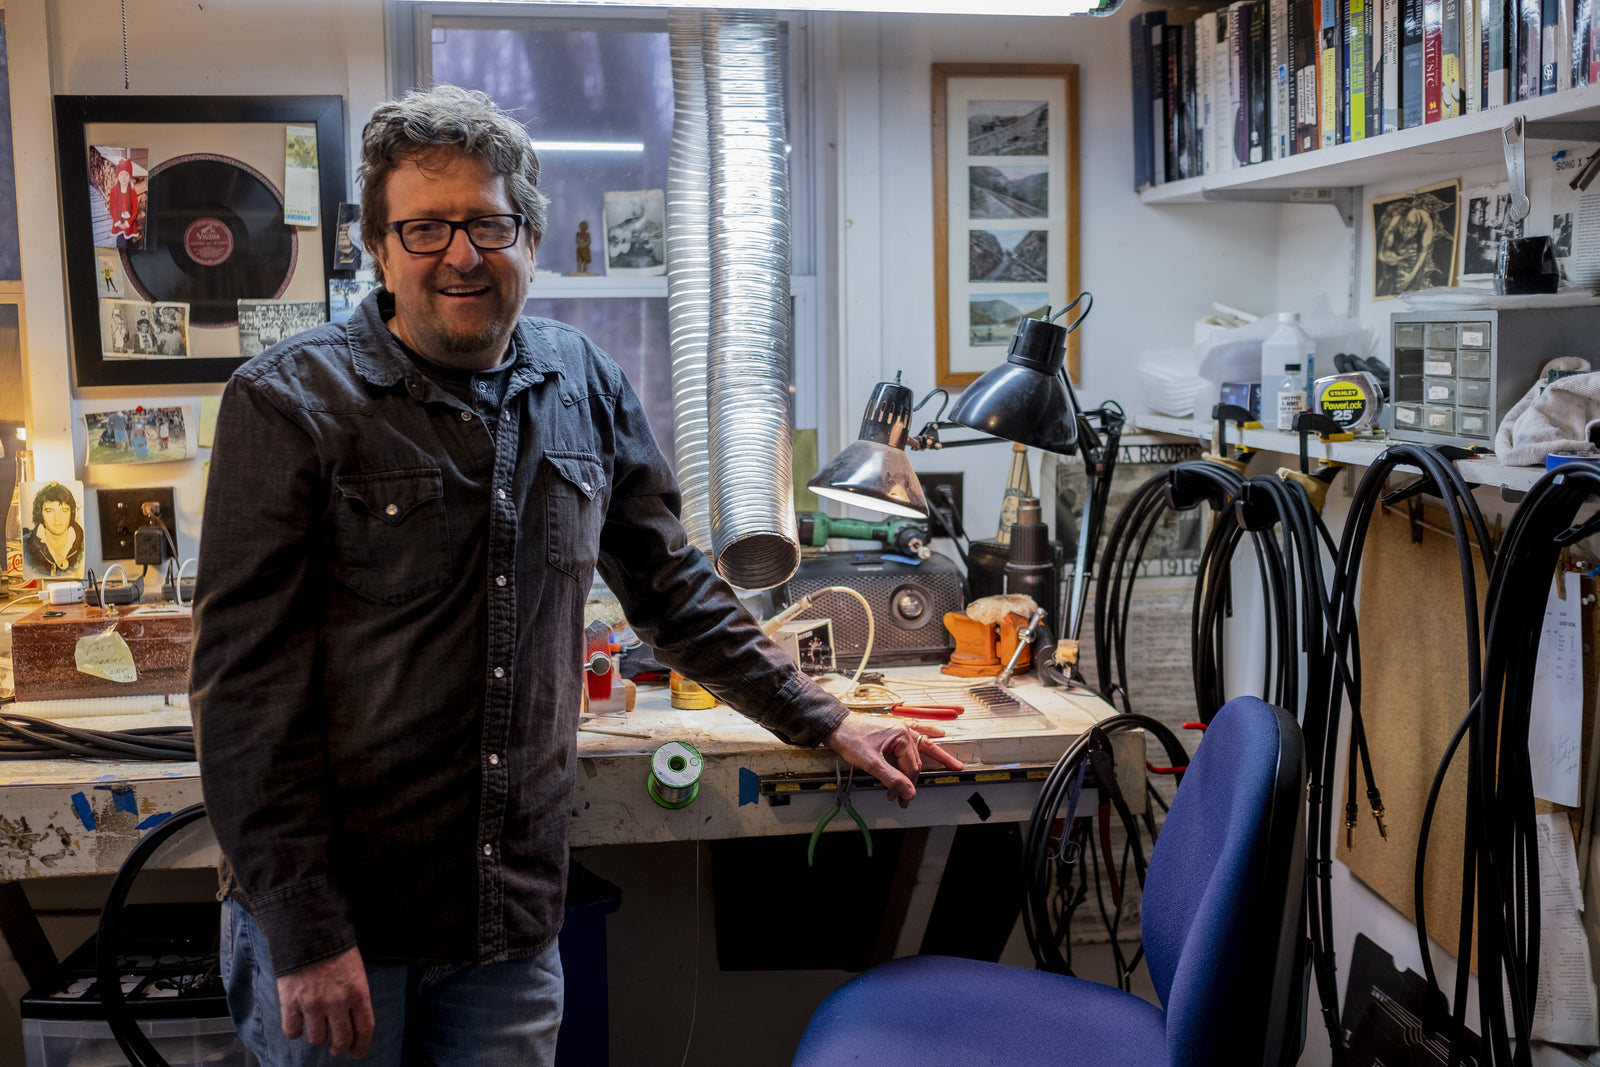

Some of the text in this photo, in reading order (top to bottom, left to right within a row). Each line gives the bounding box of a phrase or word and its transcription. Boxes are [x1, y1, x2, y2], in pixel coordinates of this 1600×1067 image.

[1426, 39, 1434, 87] MUSIC
[1556, 160, 1576, 171] SONG
[1323, 401, 1362, 410] PowerLock
[1160, 559, 1199, 576] 1916
